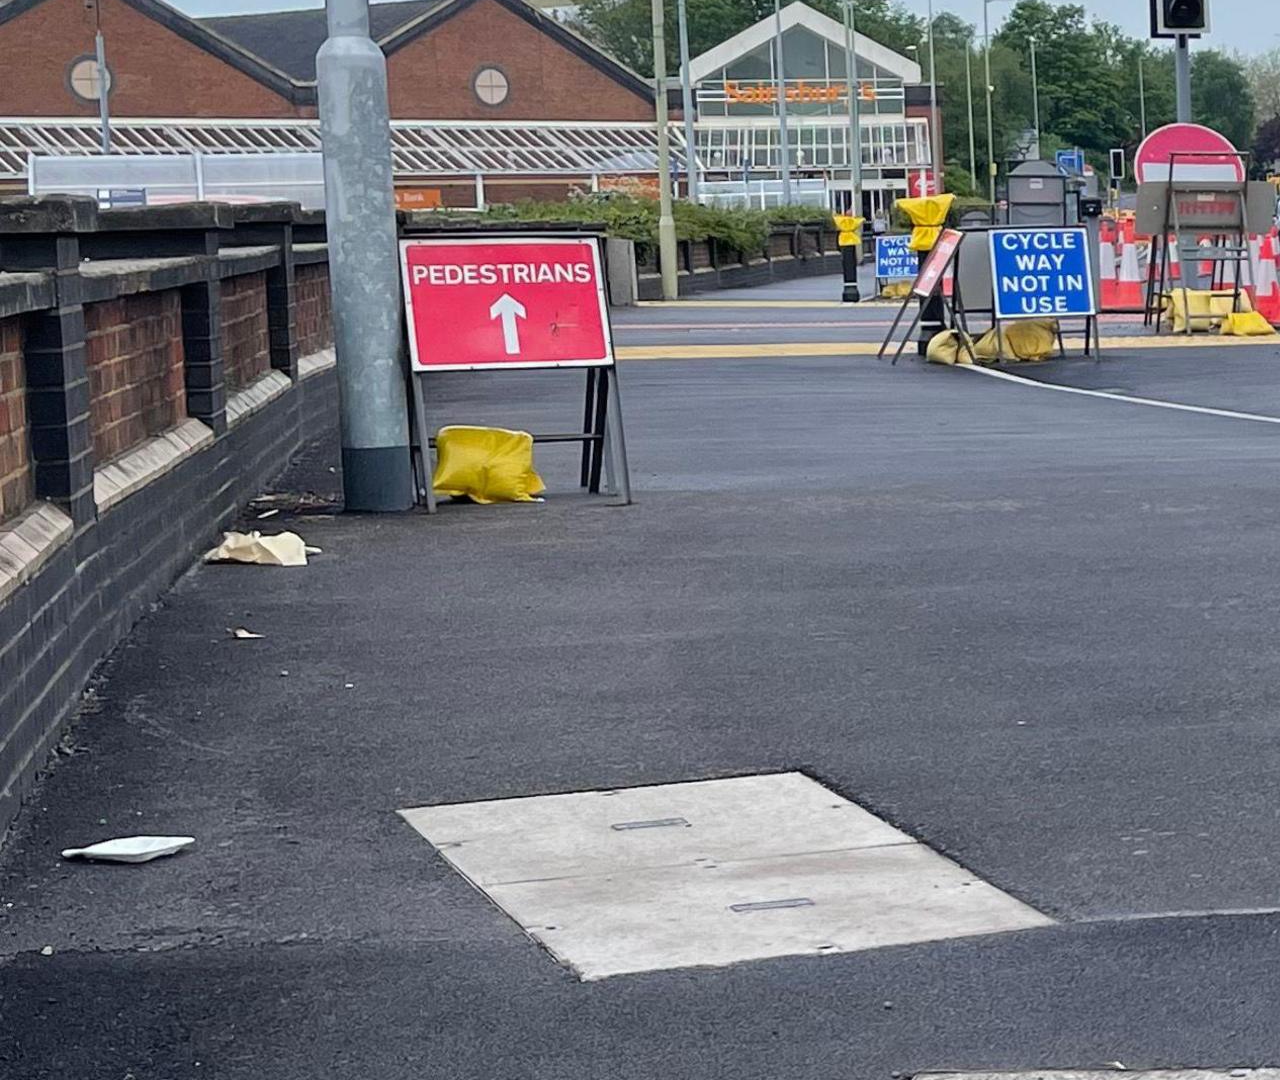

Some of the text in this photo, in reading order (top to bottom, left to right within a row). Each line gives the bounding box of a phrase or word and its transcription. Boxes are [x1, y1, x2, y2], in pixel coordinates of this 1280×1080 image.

[881, 238, 911, 247] CYCL
[1002, 233, 1077, 250] CYCLE
[887, 248, 910, 256] WAY
[880, 256, 919, 266] NOT IN
[1015, 253, 1065, 271] WAY
[412, 263, 592, 286] PEDESTRIANS
[888, 266, 911, 275] USE
[1002, 274, 1084, 292] NOT IN
[1021, 295, 1069, 313] USE
